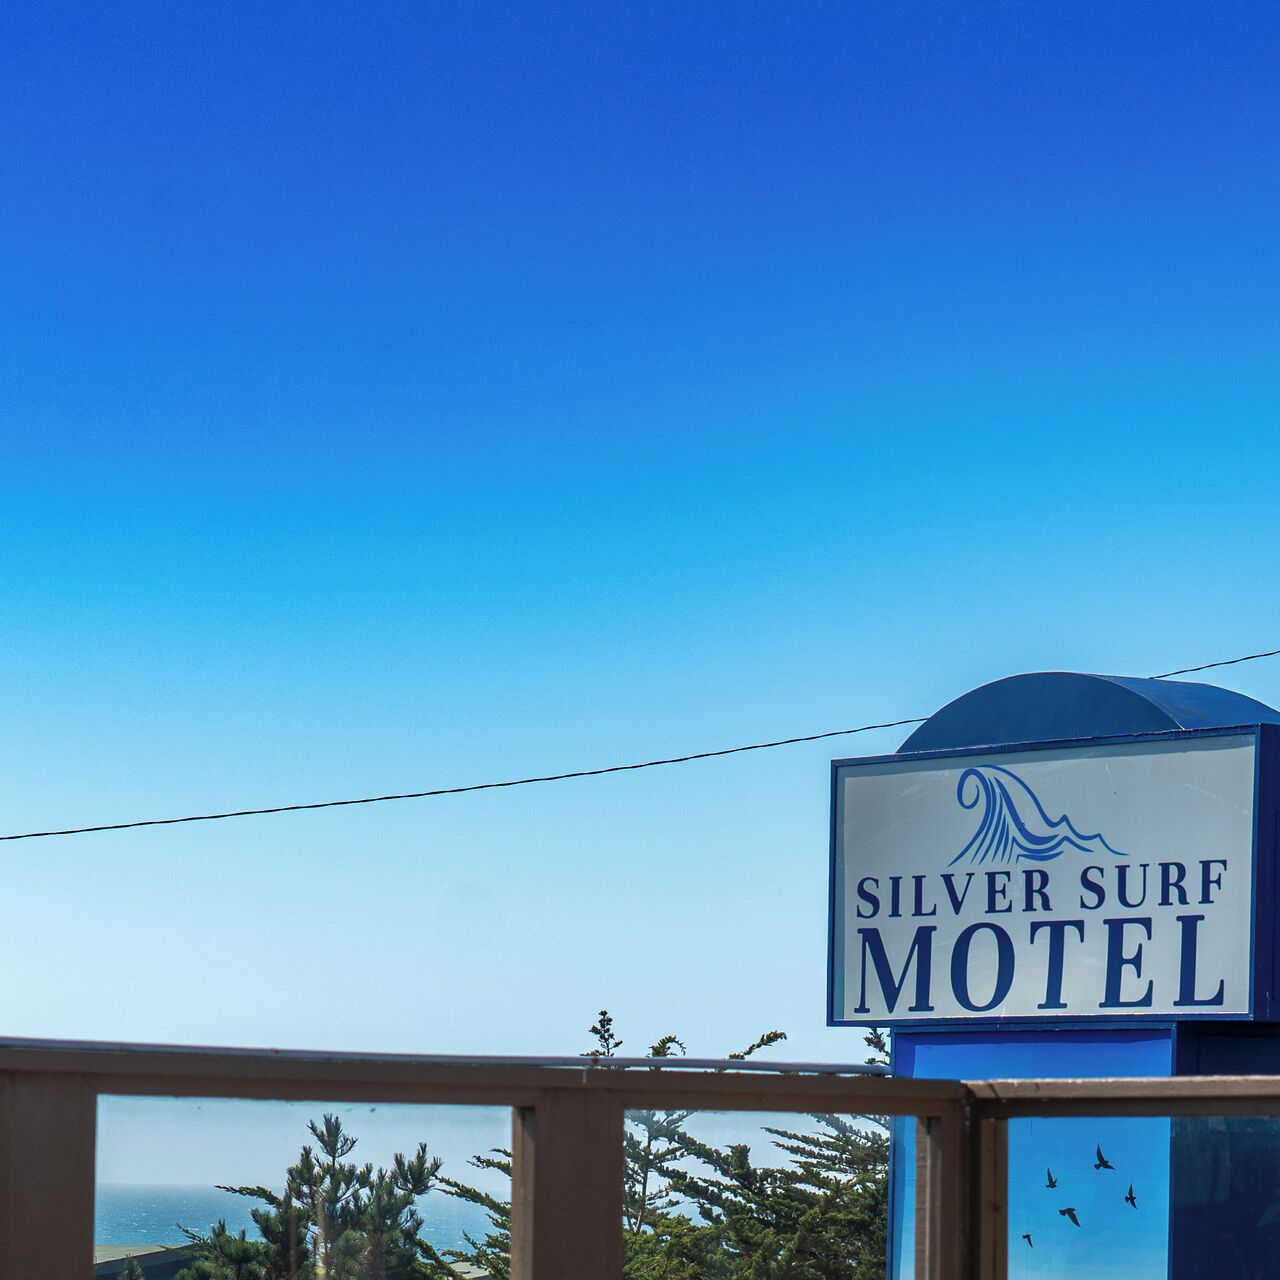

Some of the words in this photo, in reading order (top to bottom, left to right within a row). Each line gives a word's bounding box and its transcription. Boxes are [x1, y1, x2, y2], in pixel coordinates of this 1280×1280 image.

[857, 870, 1052, 918] SILVER
[1080, 859, 1227, 910] SURF
[855, 915, 1225, 1013] MOTEL
